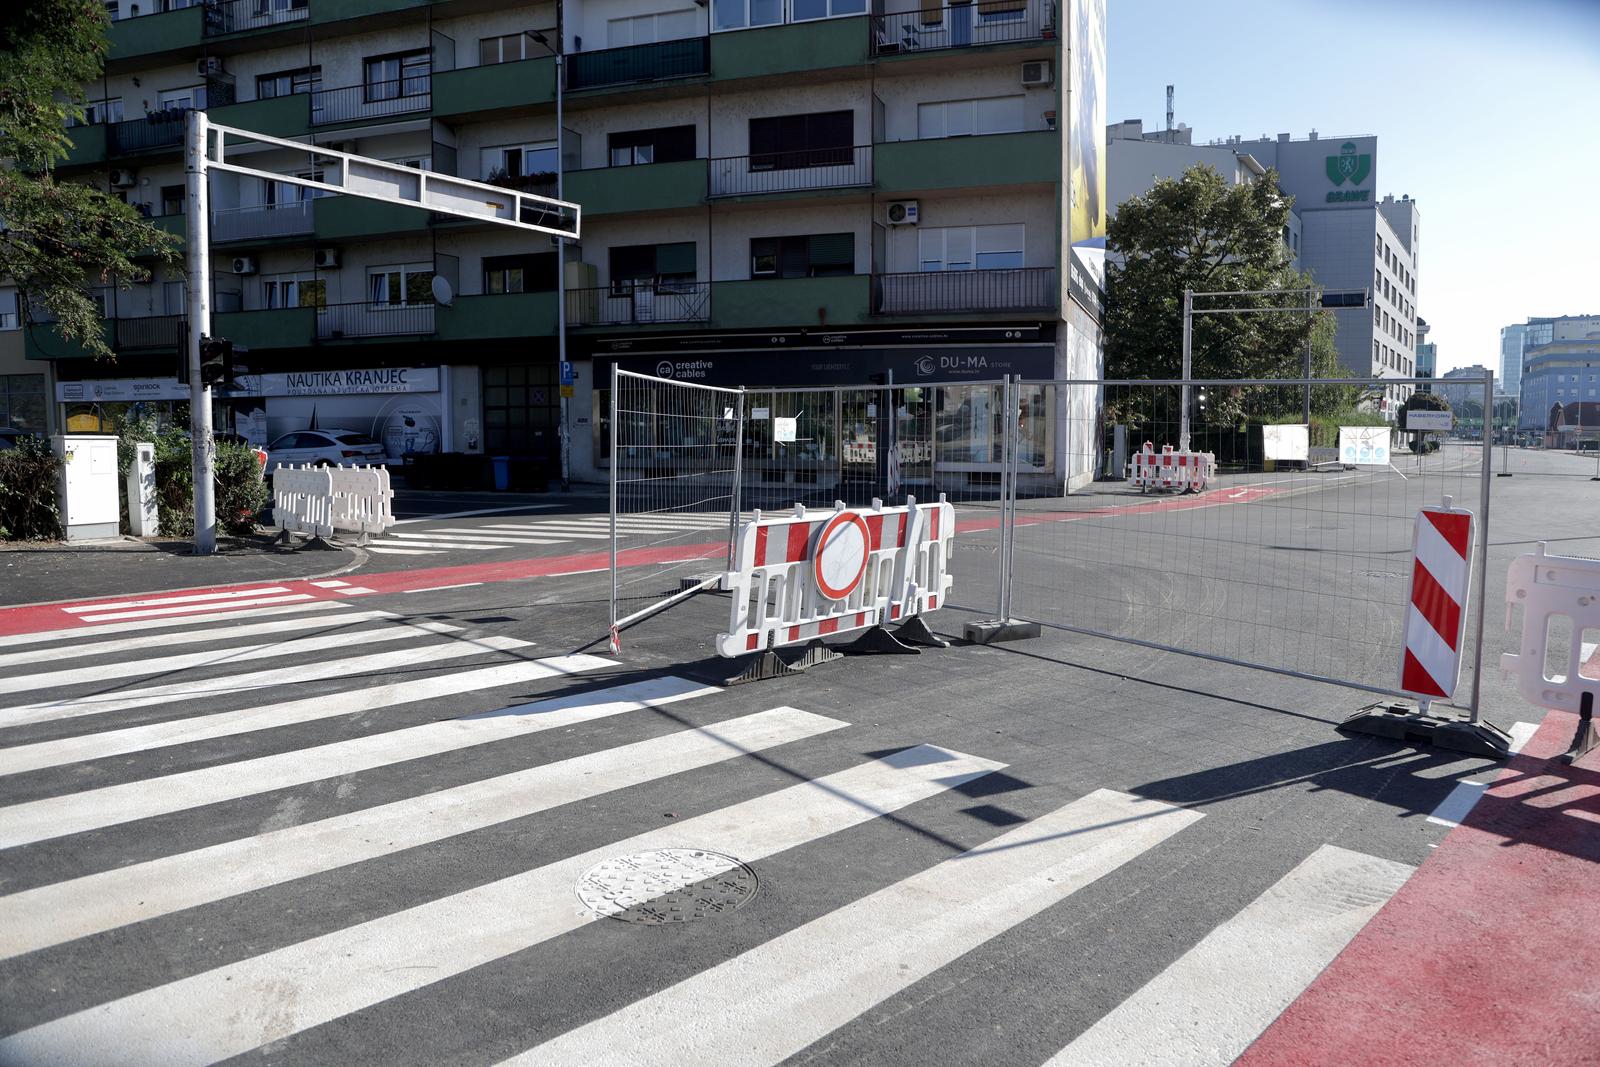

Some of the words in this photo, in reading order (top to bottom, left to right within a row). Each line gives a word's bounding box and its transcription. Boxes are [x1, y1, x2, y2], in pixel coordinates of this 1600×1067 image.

[675, 360, 713, 370] creative
[940, 355, 988, 368] DU-MA
[563, 361, 570, 379] P
[675, 369, 706, 378] cables
[286, 373, 342, 388] NAUTIKA
[345, 369, 408, 386] KRANJEC
[375, 385, 408, 393] OPREMA
